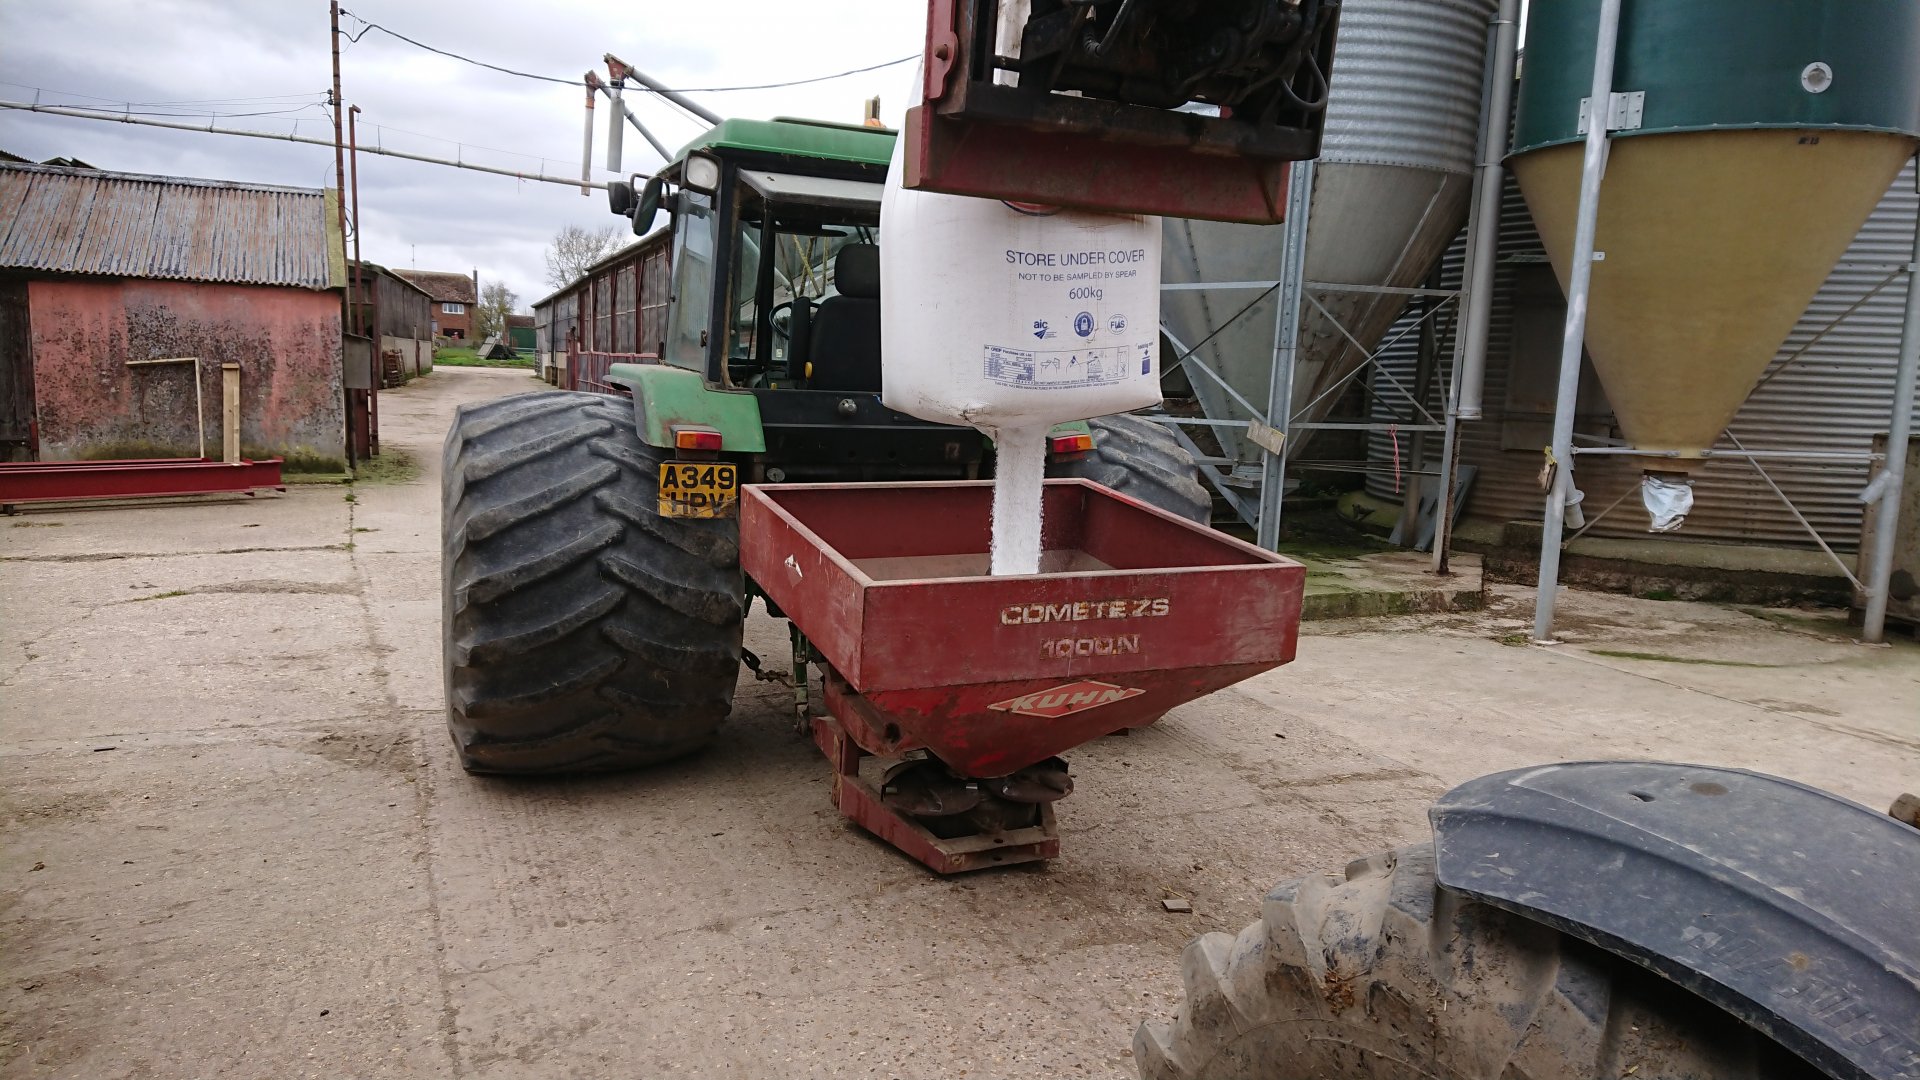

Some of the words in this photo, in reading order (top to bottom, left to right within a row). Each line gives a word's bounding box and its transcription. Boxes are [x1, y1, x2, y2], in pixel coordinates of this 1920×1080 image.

[1006, 250, 1056, 266] STORE
[1060, 252, 1105, 266] UNDER
[1108, 249, 1145, 263] COVER
[1018, 272, 1037, 281] NOT
[1040, 273, 1051, 282] TO
[1067, 271, 1103, 281] SAMPLED
[1104, 271, 1114, 279] BY
[1115, 269, 1137, 278] SPEAR
[1069, 285, 1103, 301] 600kg
[1033, 318, 1048, 329] aic
[663, 465, 735, 489] A349
[671, 491, 725, 516] HPV
[1001, 600, 1127, 625] COMETE
[1011, 688, 1129, 711] KUHN
